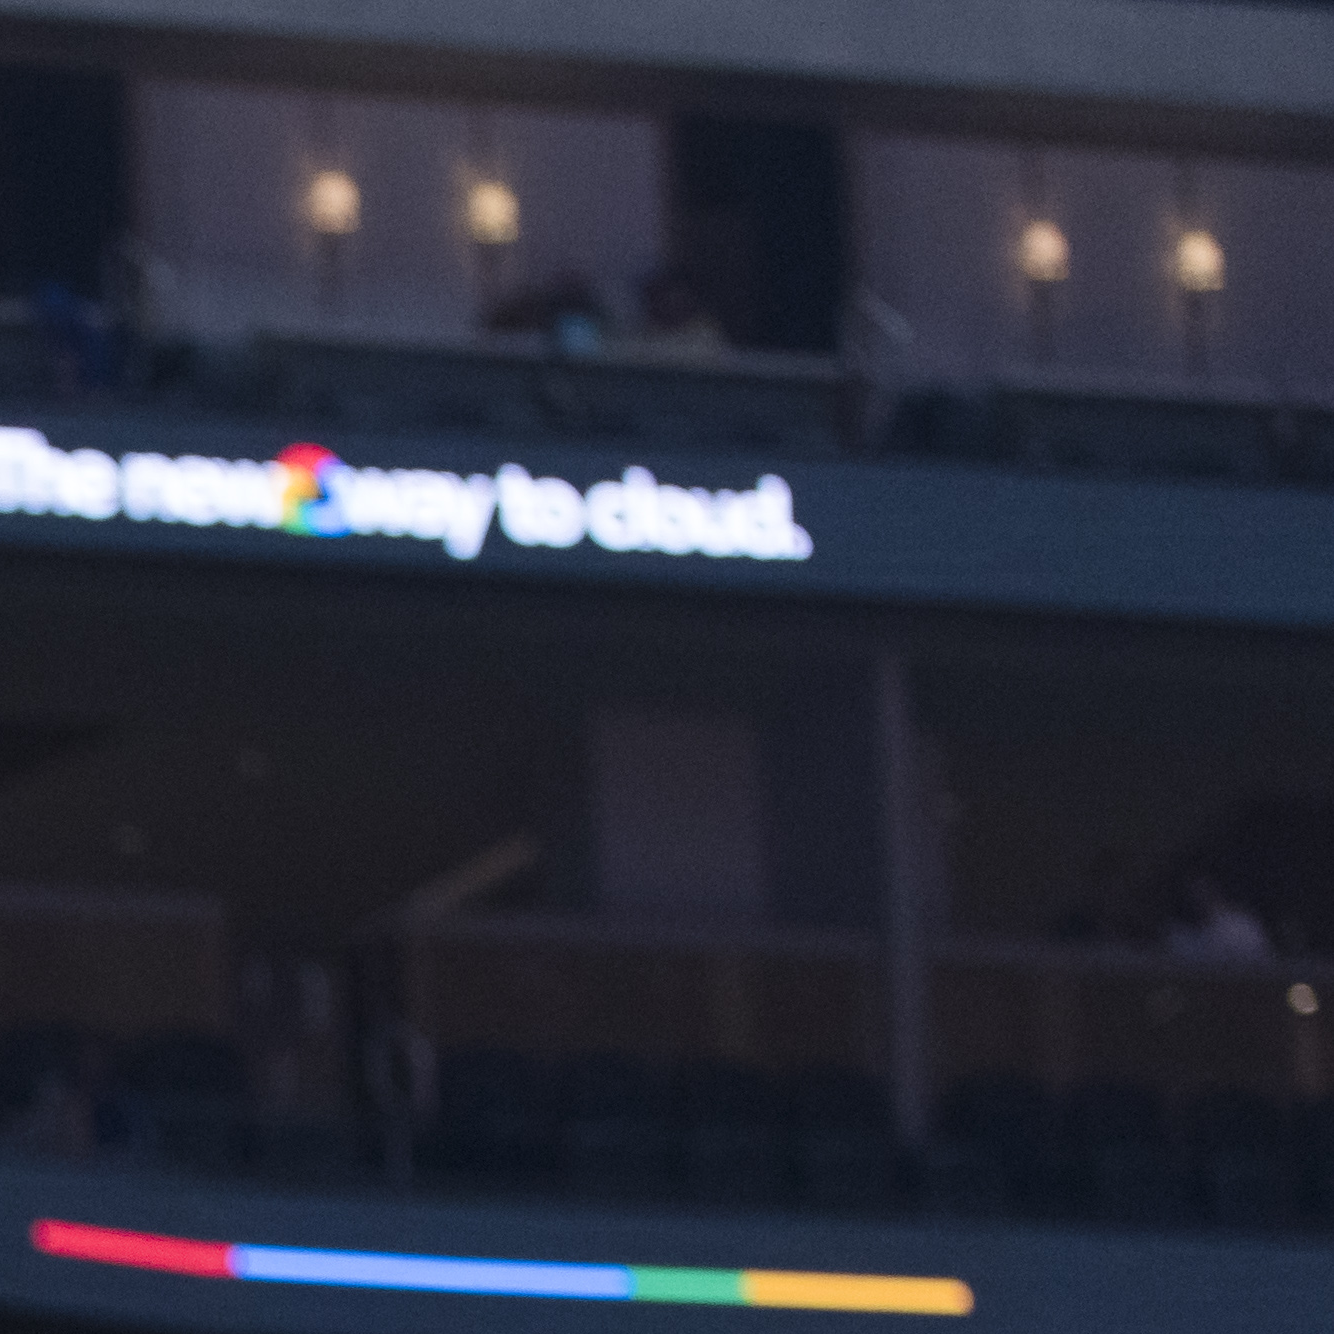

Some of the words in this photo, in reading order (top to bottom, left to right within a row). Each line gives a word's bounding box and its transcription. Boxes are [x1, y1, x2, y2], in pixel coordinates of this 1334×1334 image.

[120, 451, 290, 530] new
[326, 465, 496, 560] way
[497, 462, 582, 547] to
[586, 465, 814, 561] cloud.
